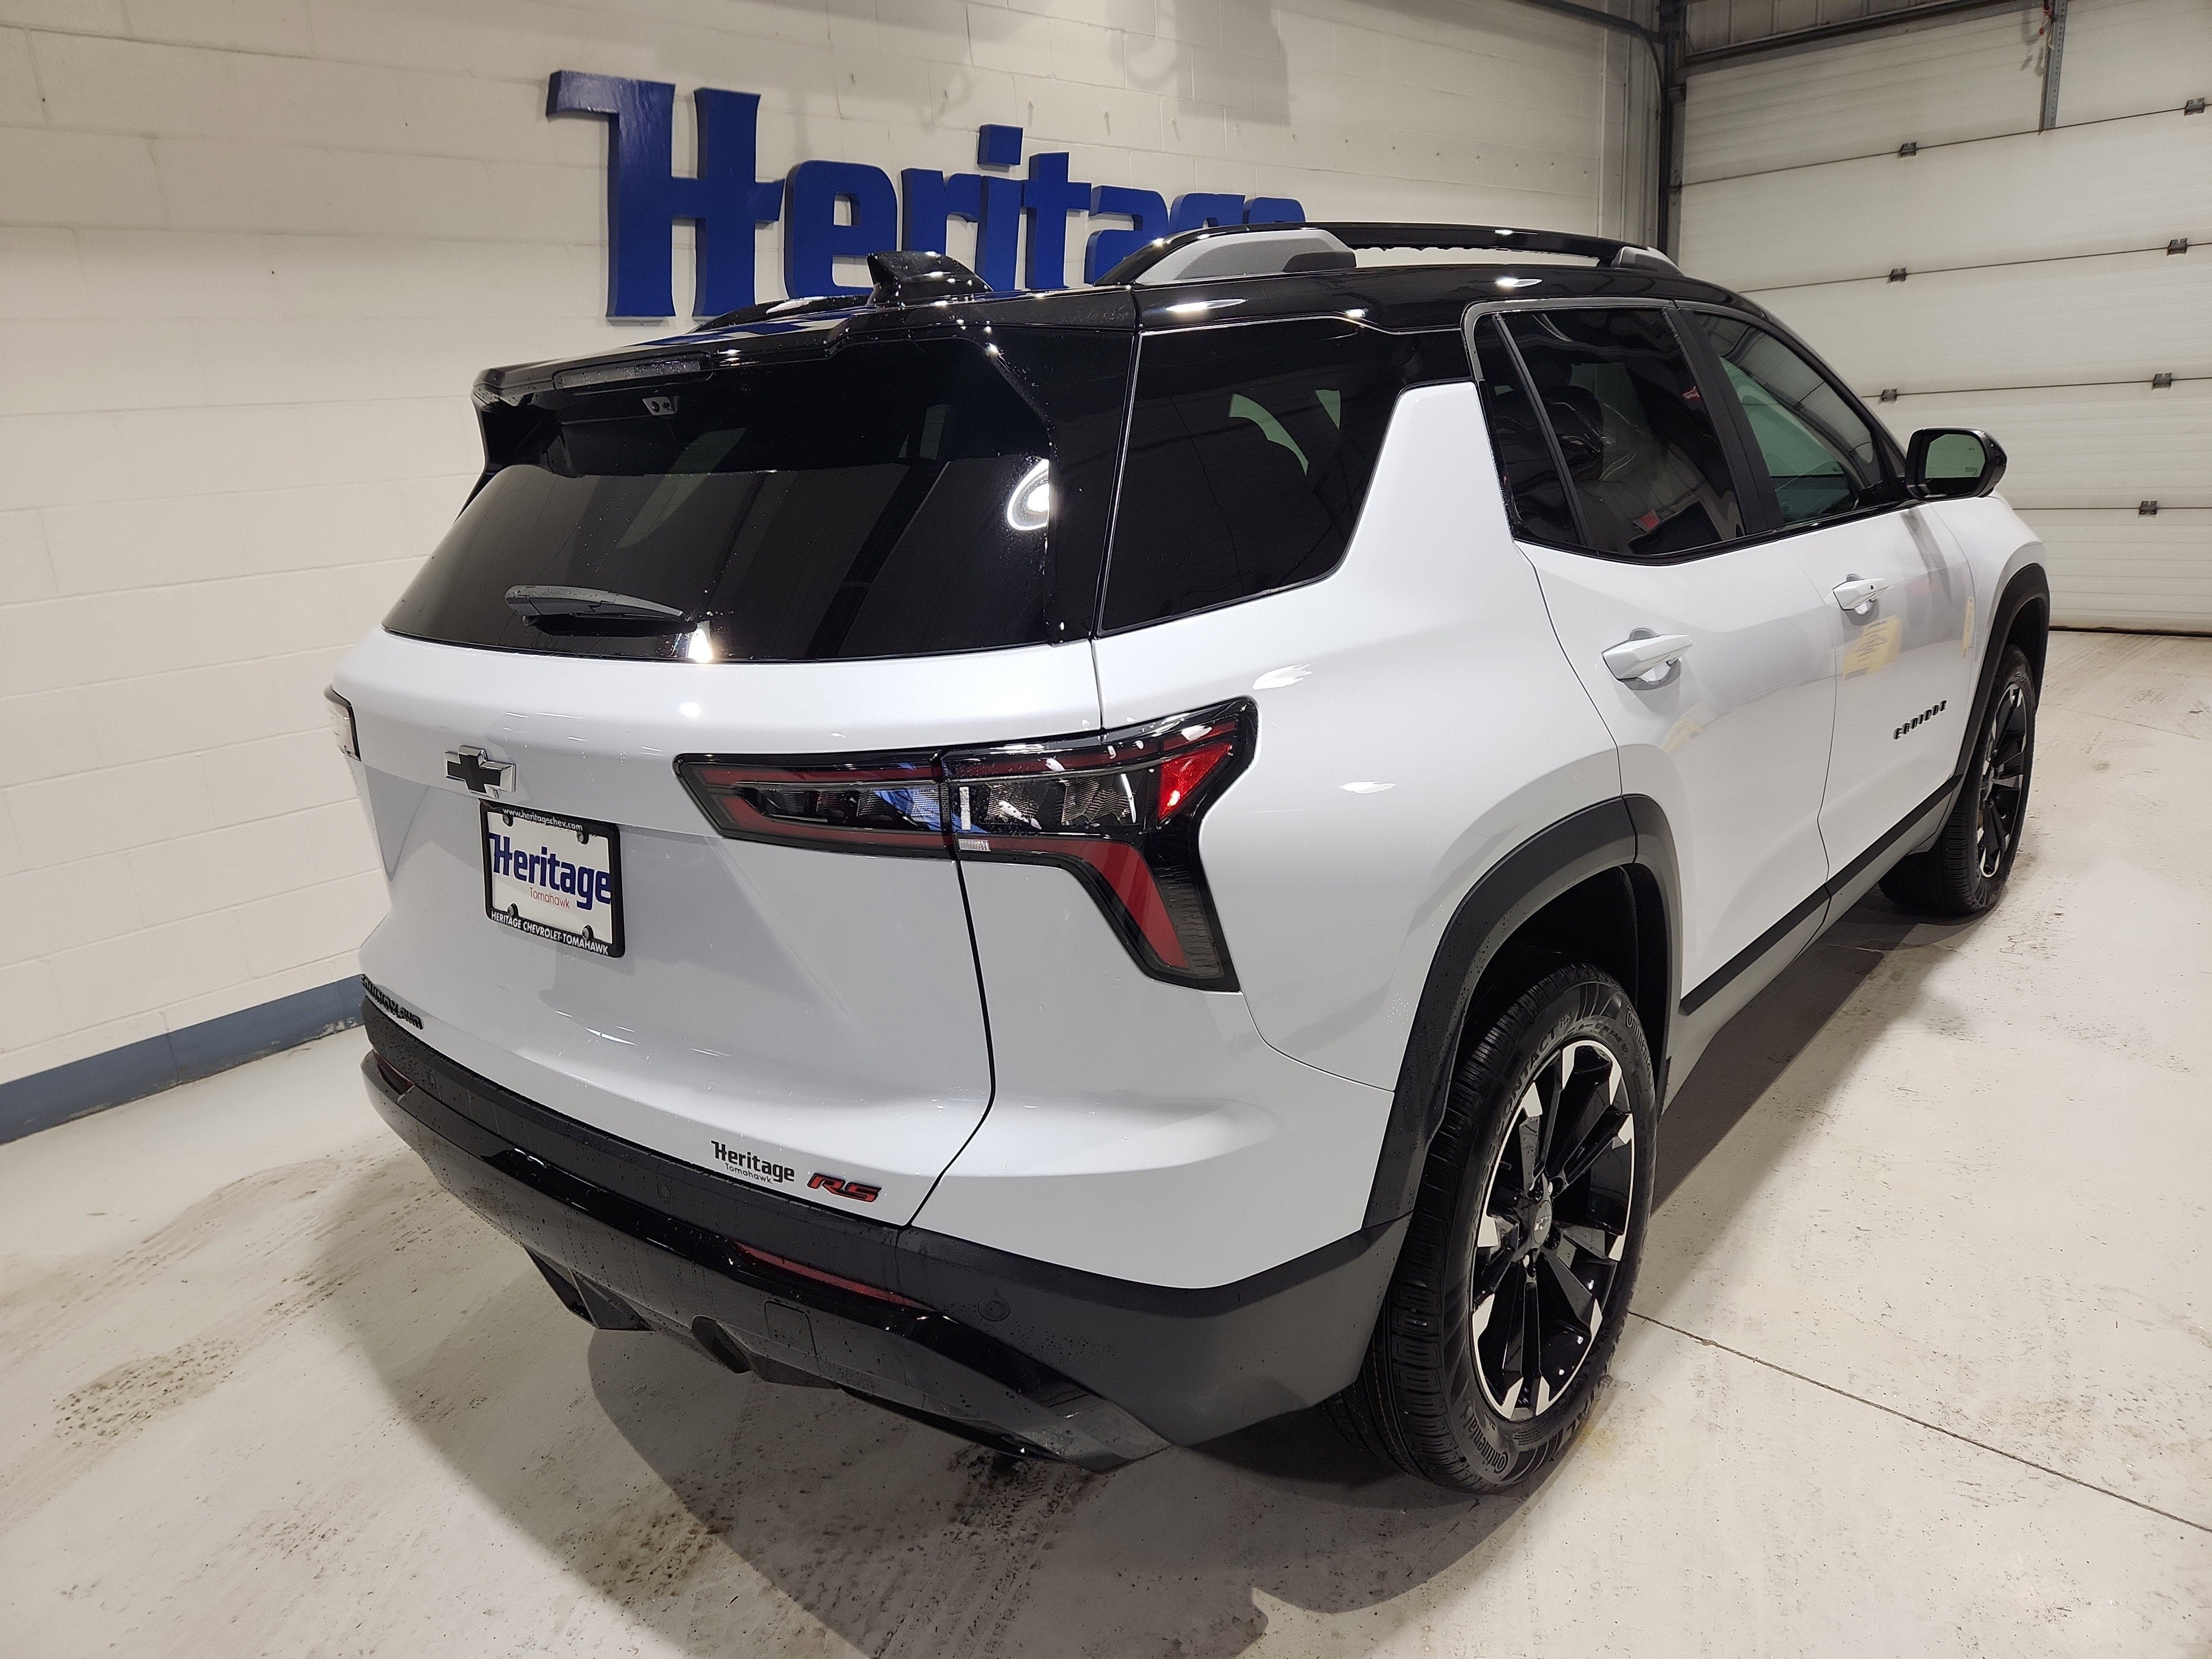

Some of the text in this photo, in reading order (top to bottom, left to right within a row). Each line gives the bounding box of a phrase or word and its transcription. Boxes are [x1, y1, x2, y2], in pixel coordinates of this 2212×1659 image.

[546, 69, 1308, 320] Herita
[502, 807, 583, 831] www.heritagechev.com
[488, 832, 612, 911] Heritage
[529, 886, 570, 910] Tomahawk
[491, 910, 522, 929] HERITAGE
[711, 1140, 795, 1184] Heritage
[724, 1162, 773, 1185] Tomahawk
[806, 1172, 882, 1204] RS
[1465, 1412, 1509, 1475] Continental
